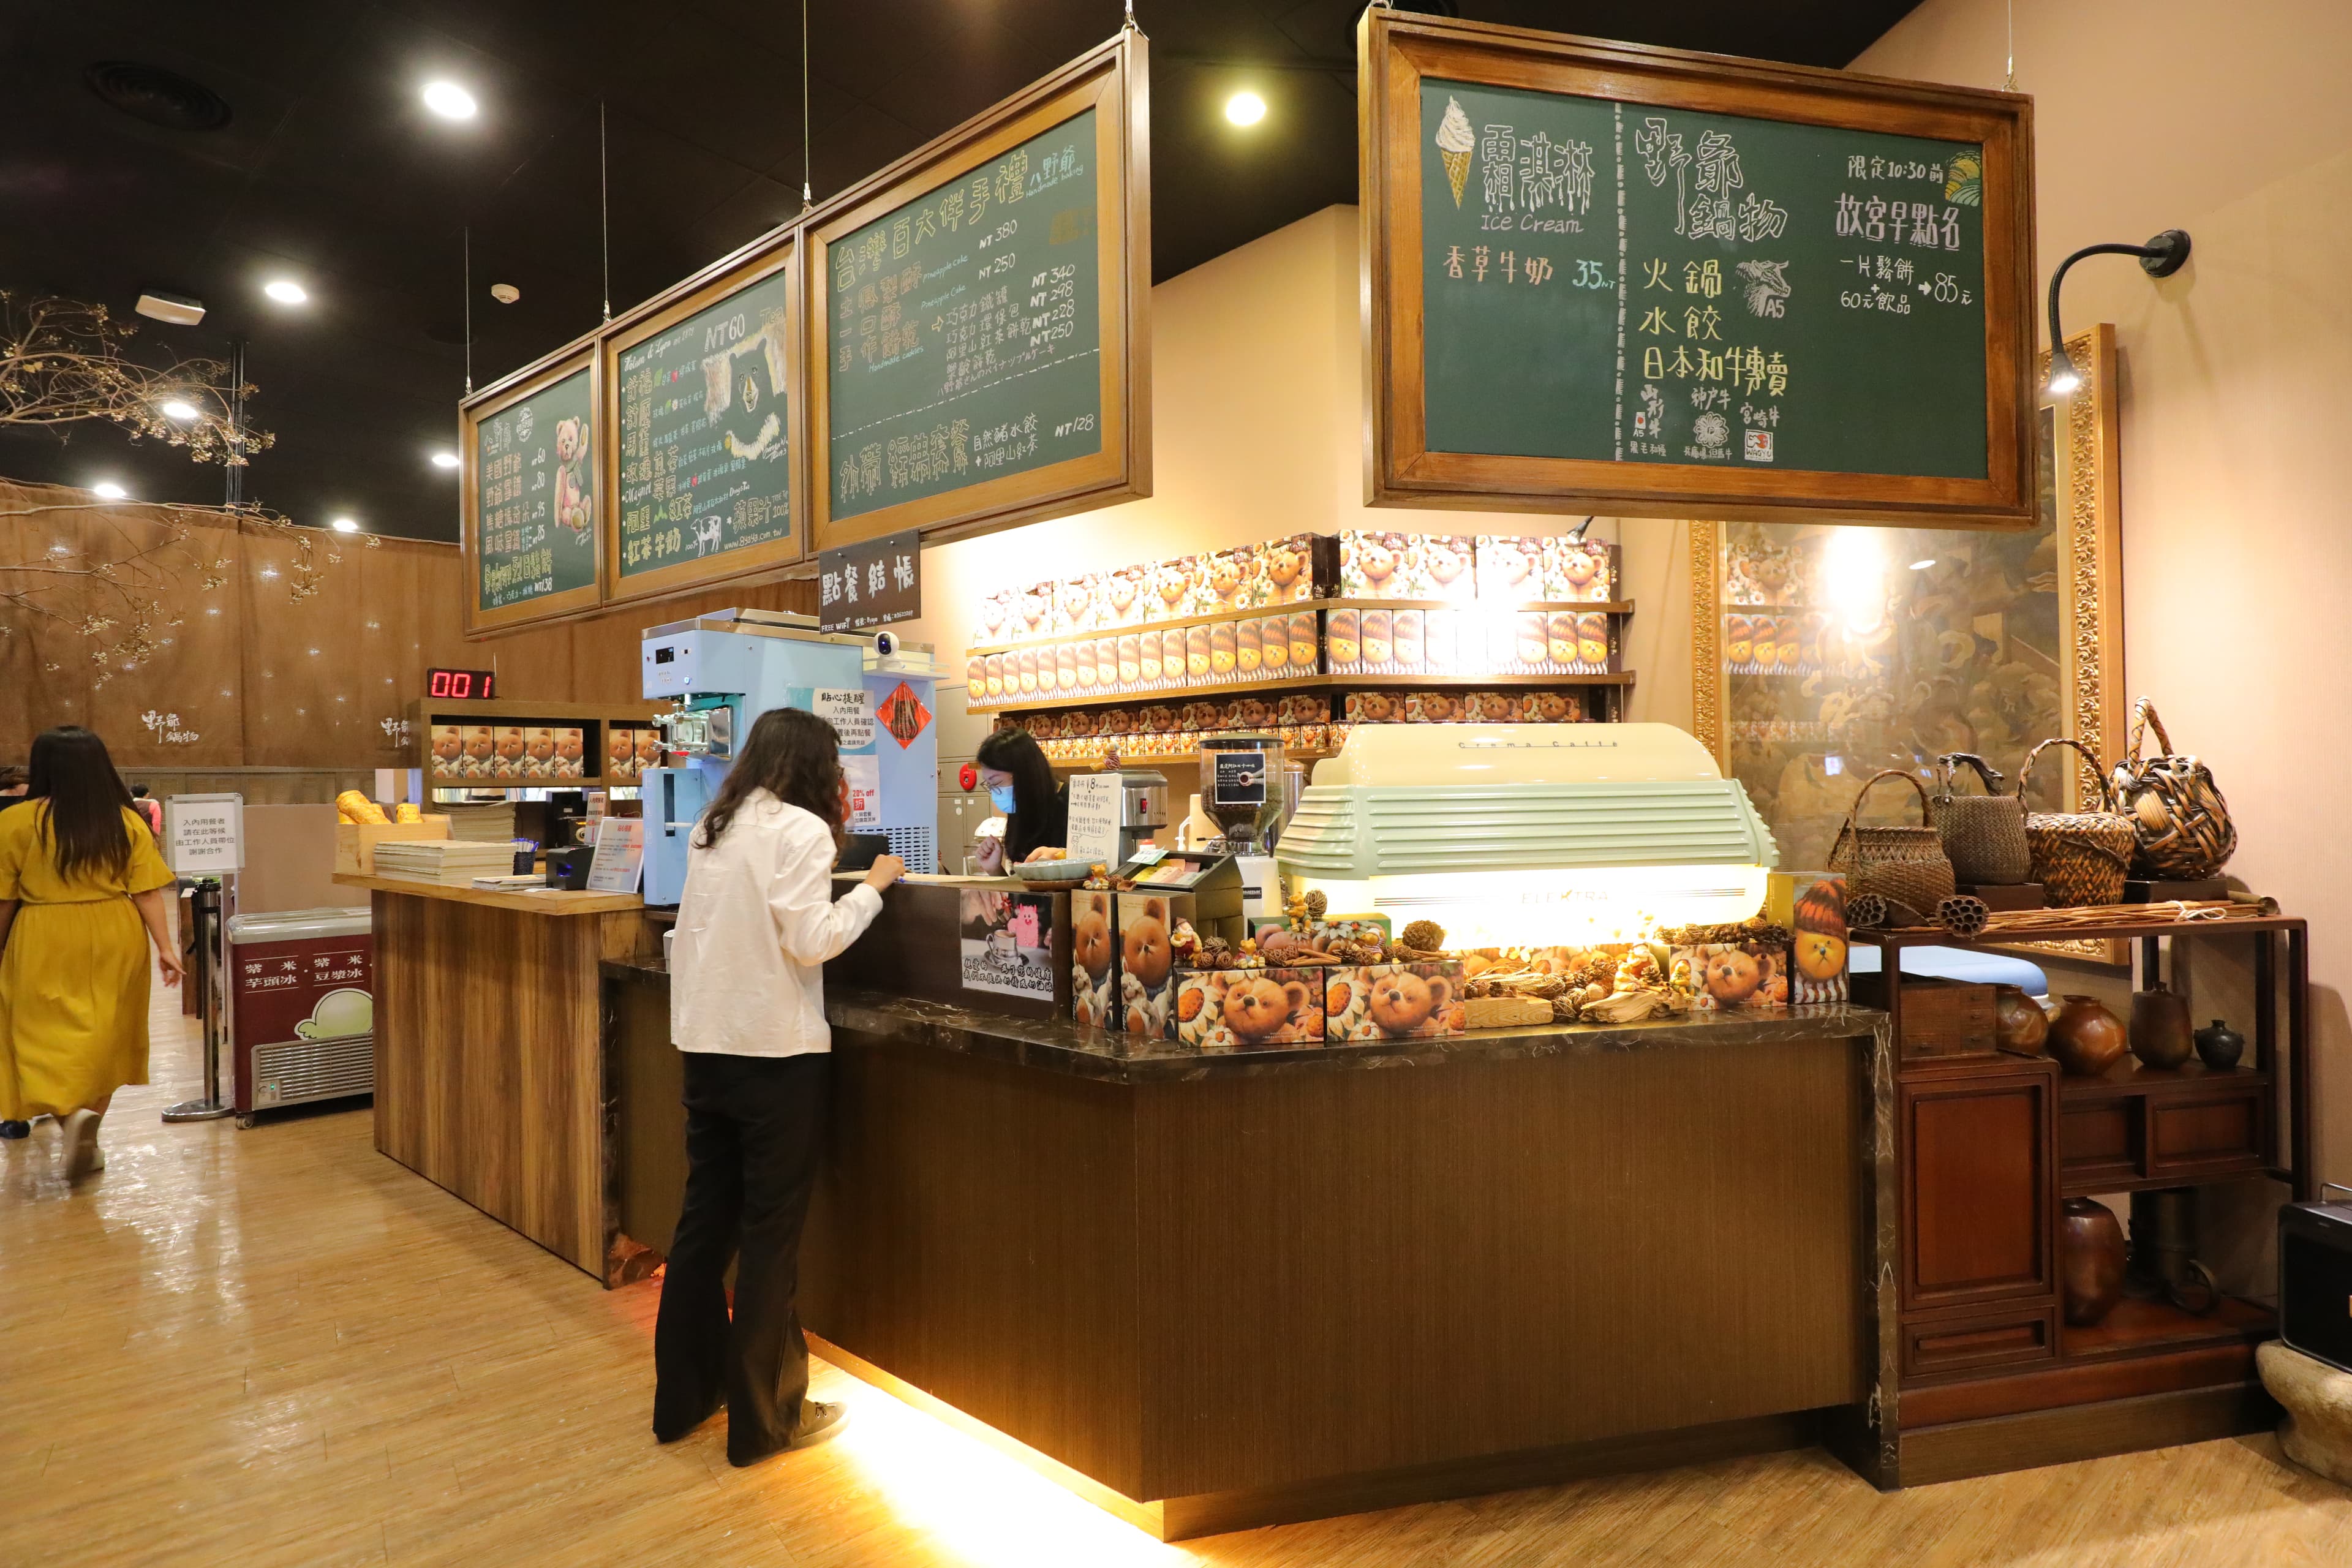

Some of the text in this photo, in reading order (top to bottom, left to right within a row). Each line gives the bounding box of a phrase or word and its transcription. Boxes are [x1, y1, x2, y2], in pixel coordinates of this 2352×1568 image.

[1025, 164, 1084, 198] Handmade baking
[1482, 124, 1596, 214] 霜淇淋
[835, 150, 1028, 293] 台灣百大伴手禮
[1481, 214, 1585, 233] Ice Cream
[1688, 192, 1788, 243] 鍋物
[1834, 192, 1961, 251] 故宮早點名
[1443, 246, 1553, 285] 香草牛奶
[1840, 254, 1915, 287] 一片鬆餅
[839, 261, 922, 320] 土鳳梨酥
[1643, 258, 1722, 300] 火鍋
[1766, 298, 1784, 319] A5
[1841, 291, 1911, 315] 60元飲品
[1638, 306, 1723, 342] 水餃
[839, 320, 919, 372] 手作餅乾
[902, 345, 924, 359] cookies
[1643, 346, 1789, 398] 日本和牛專賣
[1740, 402, 1781, 428] 宮崎牛
[1633, 429, 1645, 438] A5
[1746, 448, 1772, 458] WAGYU
[822, 554, 914, 606] 點餐結帳
[821, 624, 834, 633] FREE
[431, 671, 491, 698] 001
[821, 692, 865, 704] 貼心提醒
[833, 706, 860, 715] 入內用餐
[166, 730, 200, 743] 鍋物
[183, 827, 226, 836] 請在此等候
[1522, 889, 1608, 903] ELEKTRA
[245, 974, 297, 988] 芋頭冰
[314, 968, 363, 982] 豆漿冰
